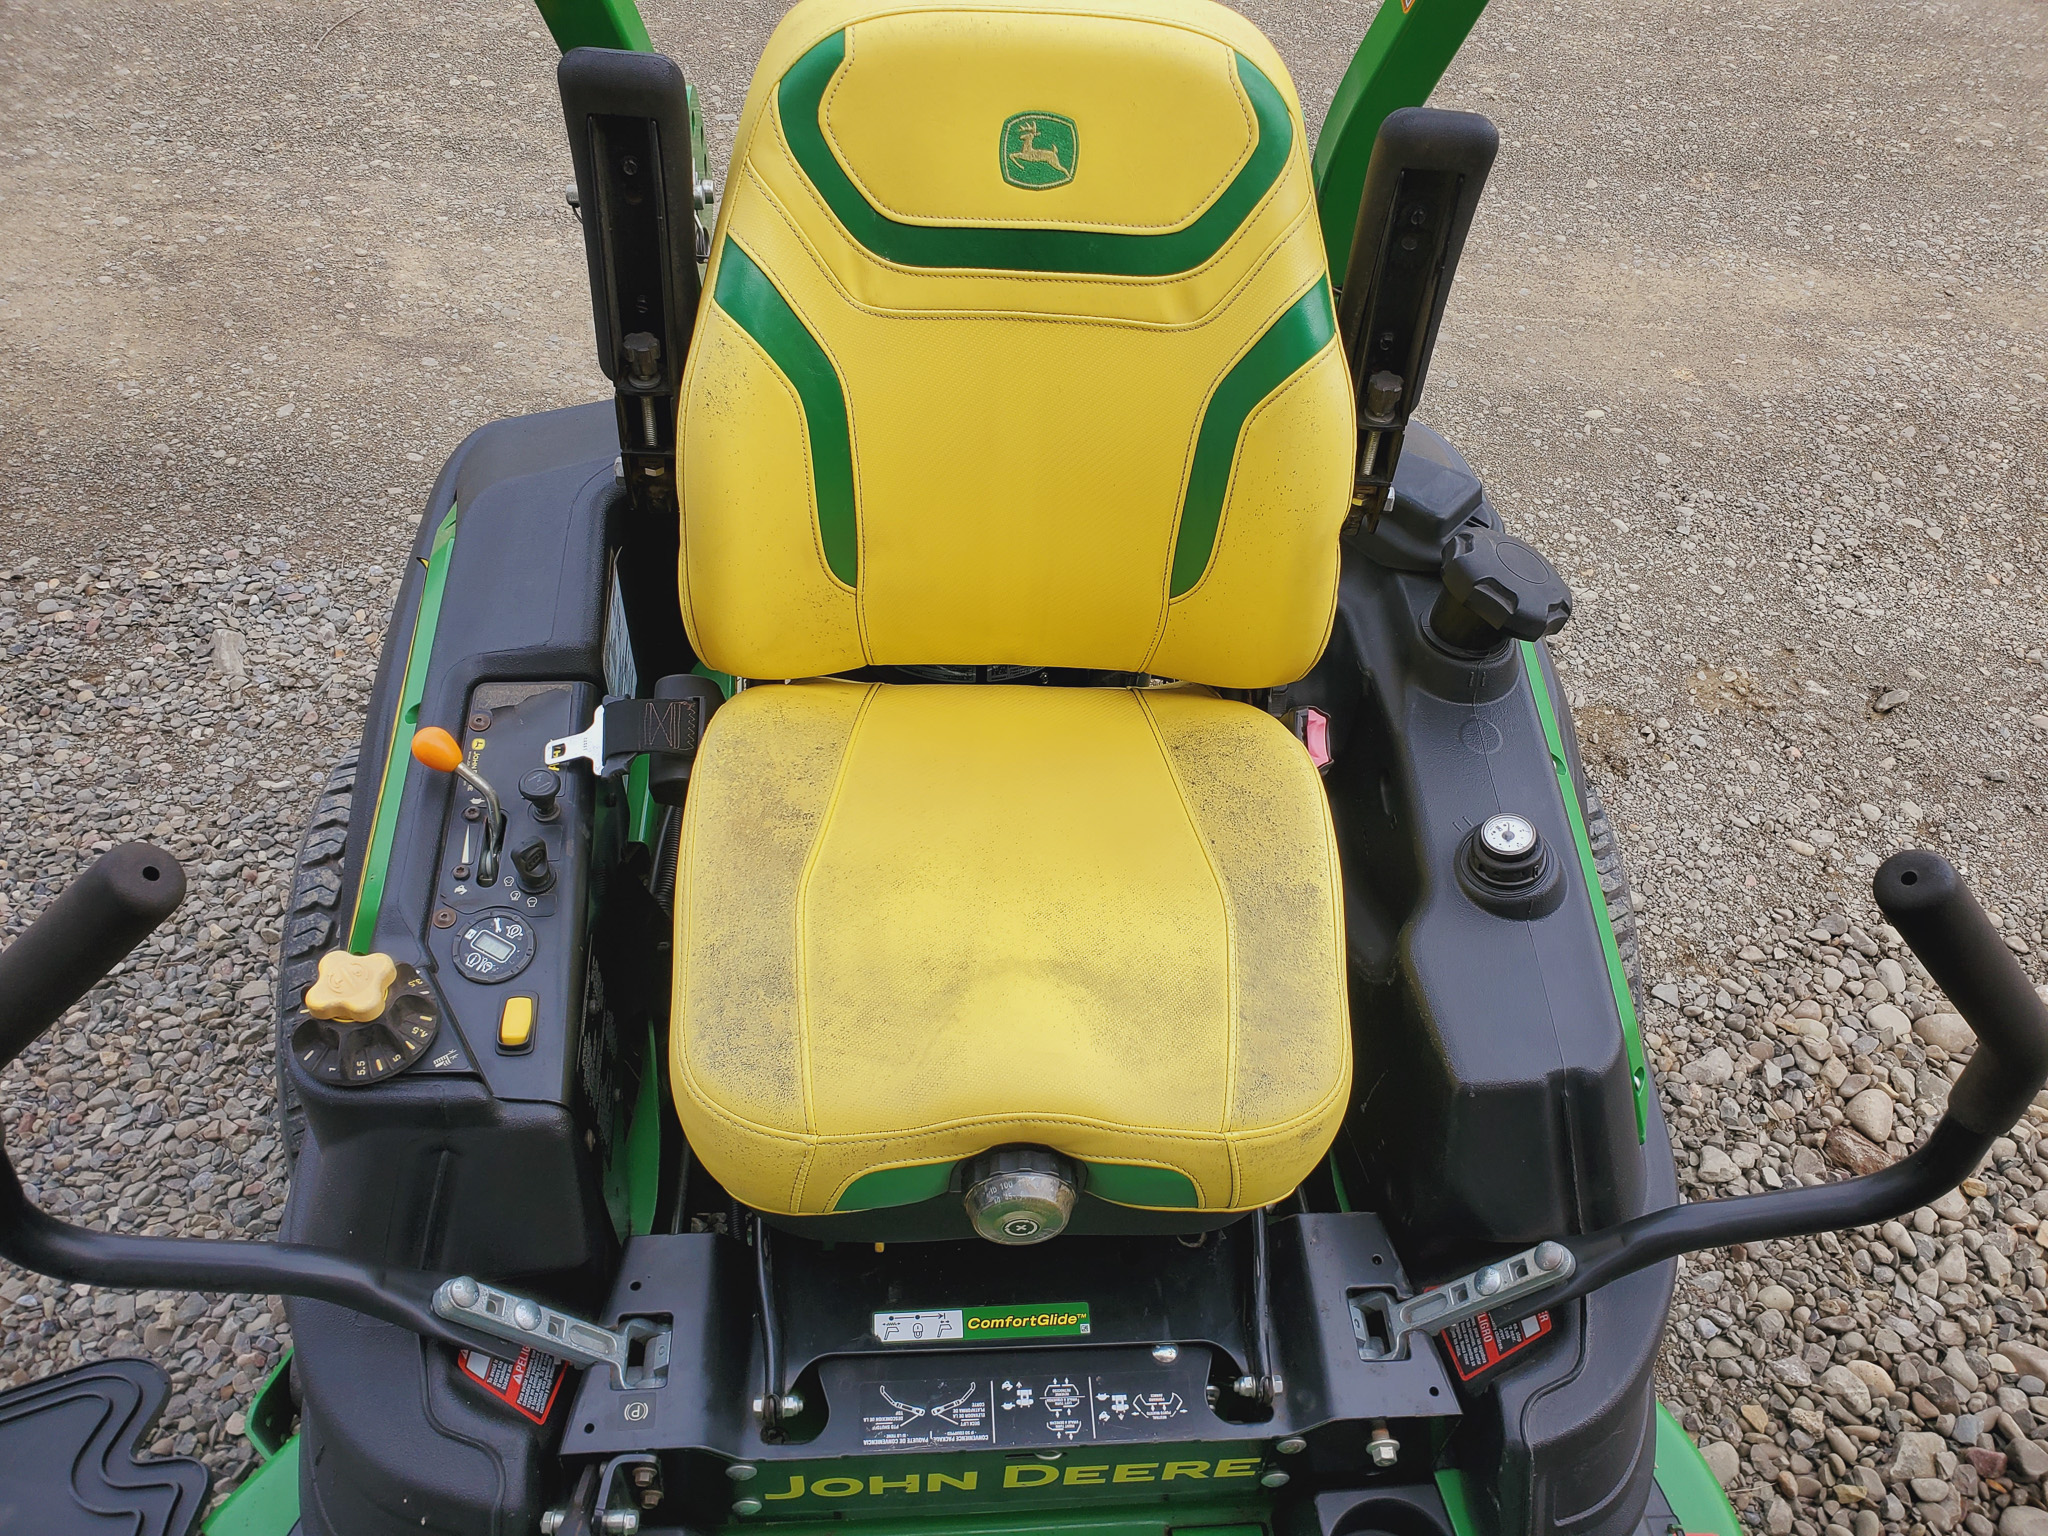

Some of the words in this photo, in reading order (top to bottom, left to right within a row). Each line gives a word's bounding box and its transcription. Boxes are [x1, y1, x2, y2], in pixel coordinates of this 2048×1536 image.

[472, 751, 480, 769] JOHN
[408, 978, 423, 987] 3.5
[412, 1026, 428, 1038] 4.5
[357, 1061, 366, 1075] 5.5
[516, 1345, 531, 1374] PELIG
[764, 1471, 978, 1500] JOHN
[1002, 1457, 1262, 1488] DEERE
